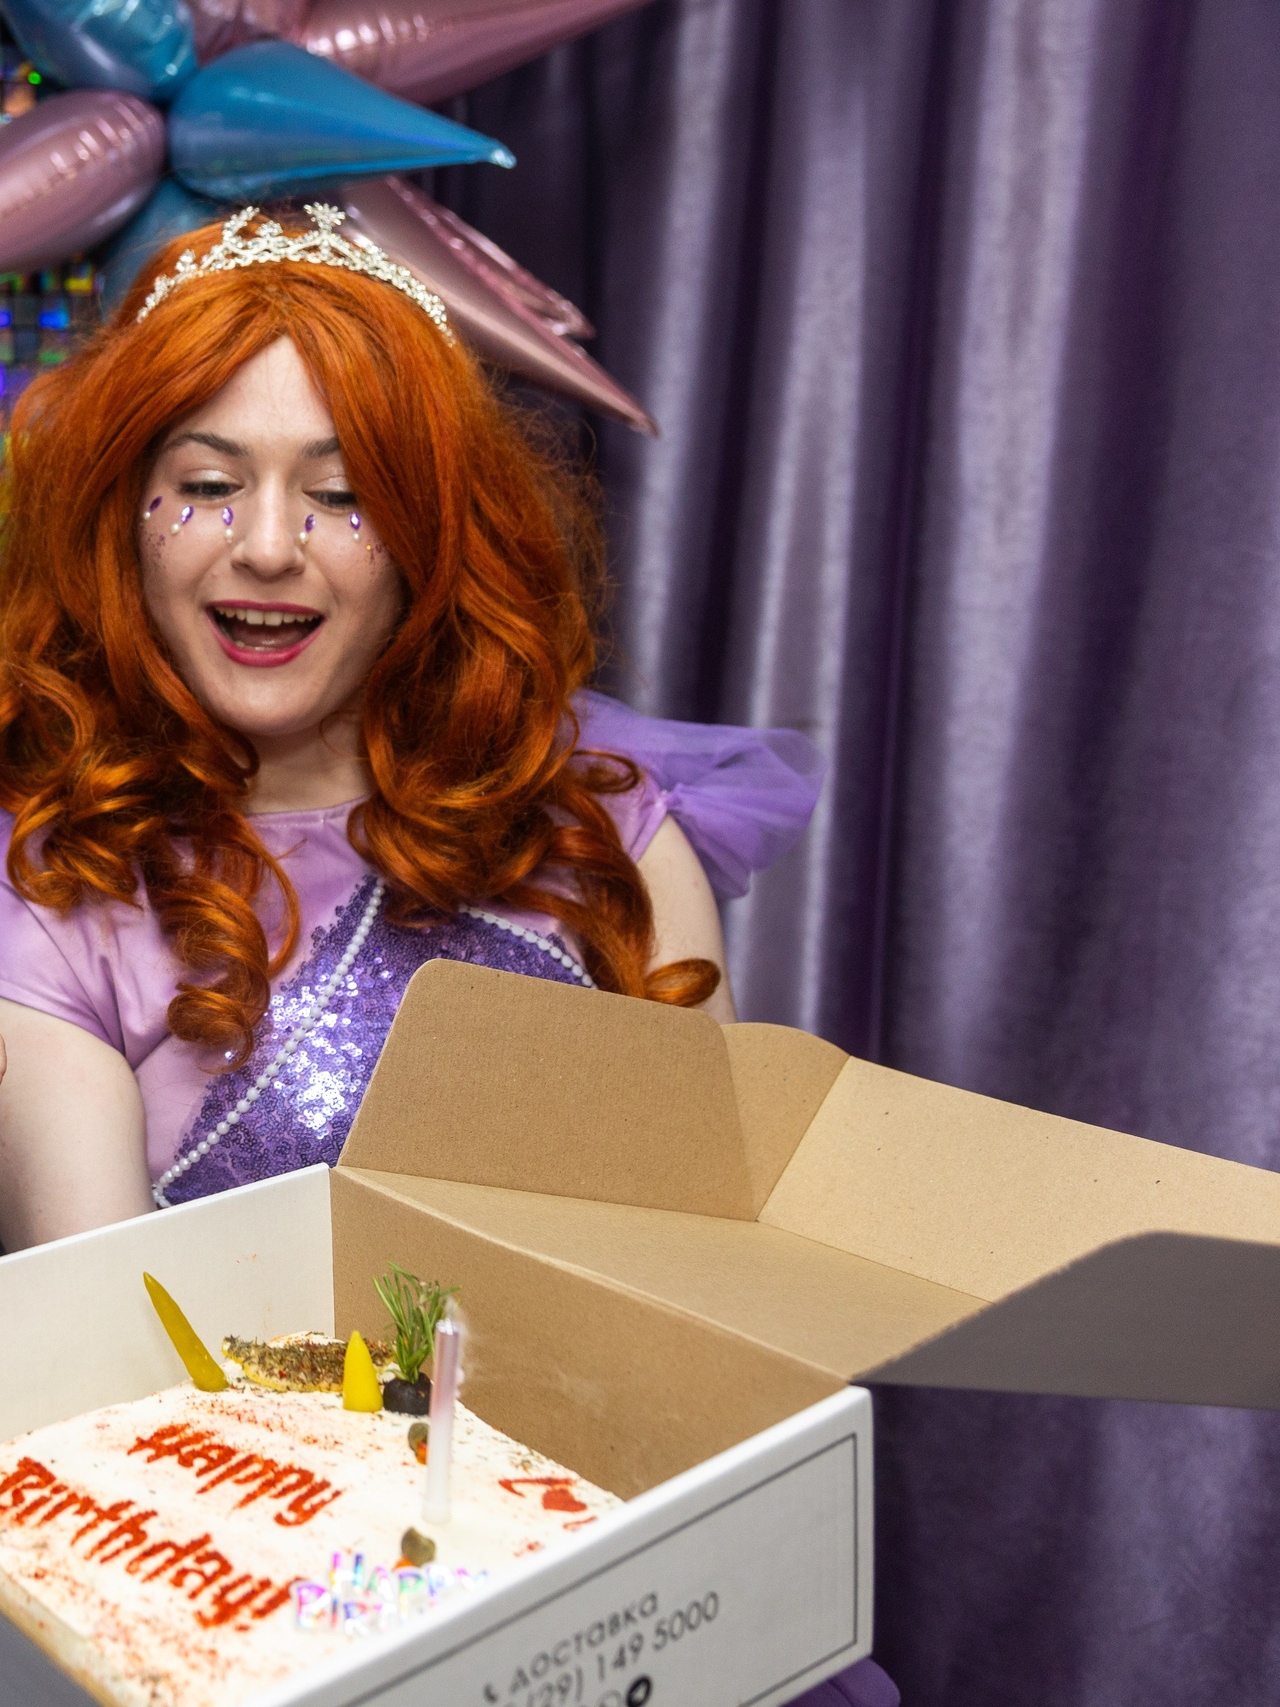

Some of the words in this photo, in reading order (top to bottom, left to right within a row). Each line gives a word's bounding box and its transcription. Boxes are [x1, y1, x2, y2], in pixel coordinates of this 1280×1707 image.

[125, 1422, 341, 1527] Happy
[596, 1631, 644, 1683] 149
[653, 1590, 720, 1652] 5000
